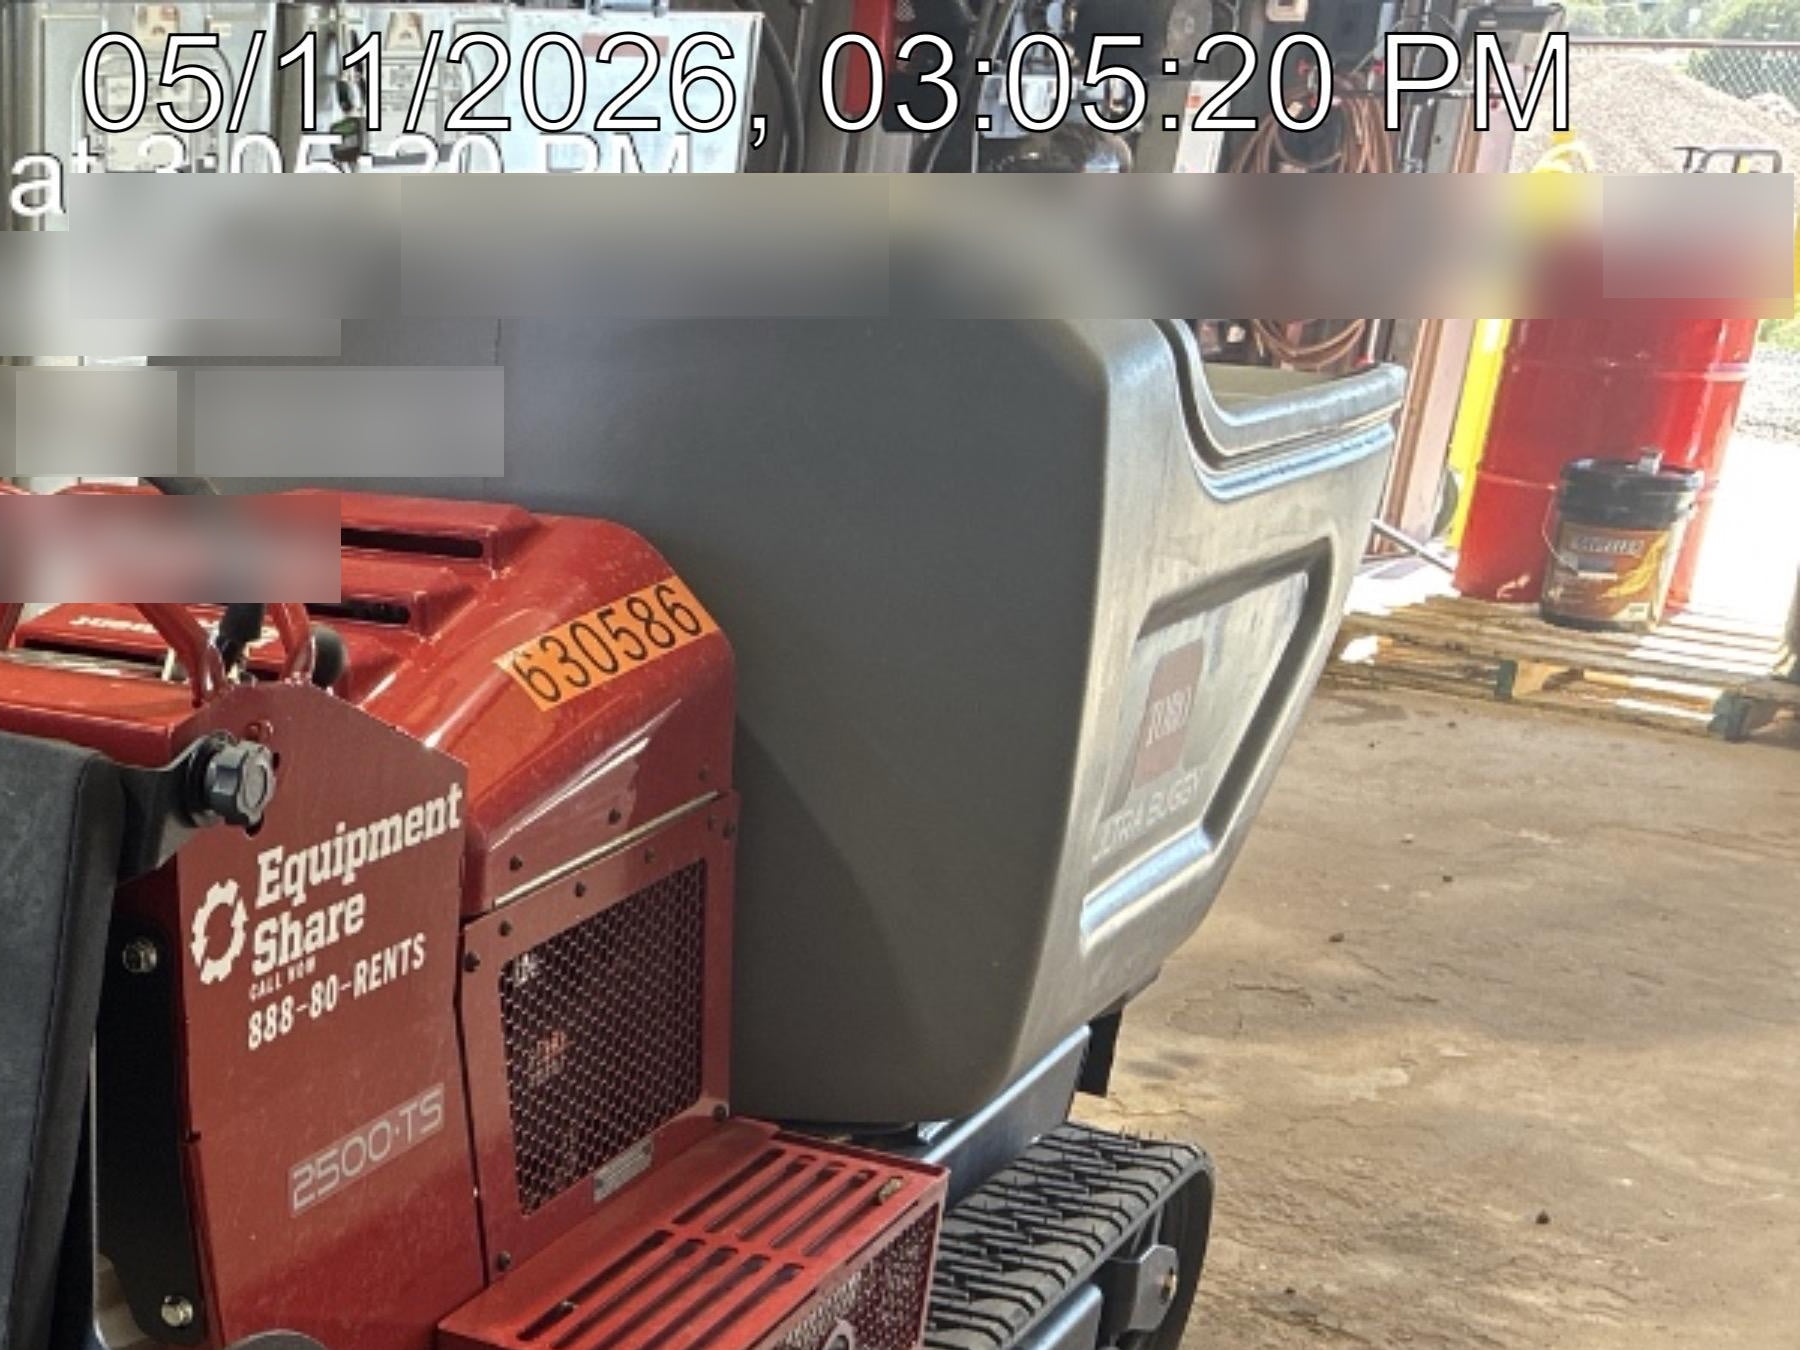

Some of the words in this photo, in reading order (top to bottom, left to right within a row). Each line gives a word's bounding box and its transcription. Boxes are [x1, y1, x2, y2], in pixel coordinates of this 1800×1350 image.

[512, 584, 703, 703] 630586
[254, 782, 463, 909] Equipment
[248, 932, 426, 1050] 888-80-RENTS
[252, 893, 366, 976] Share
